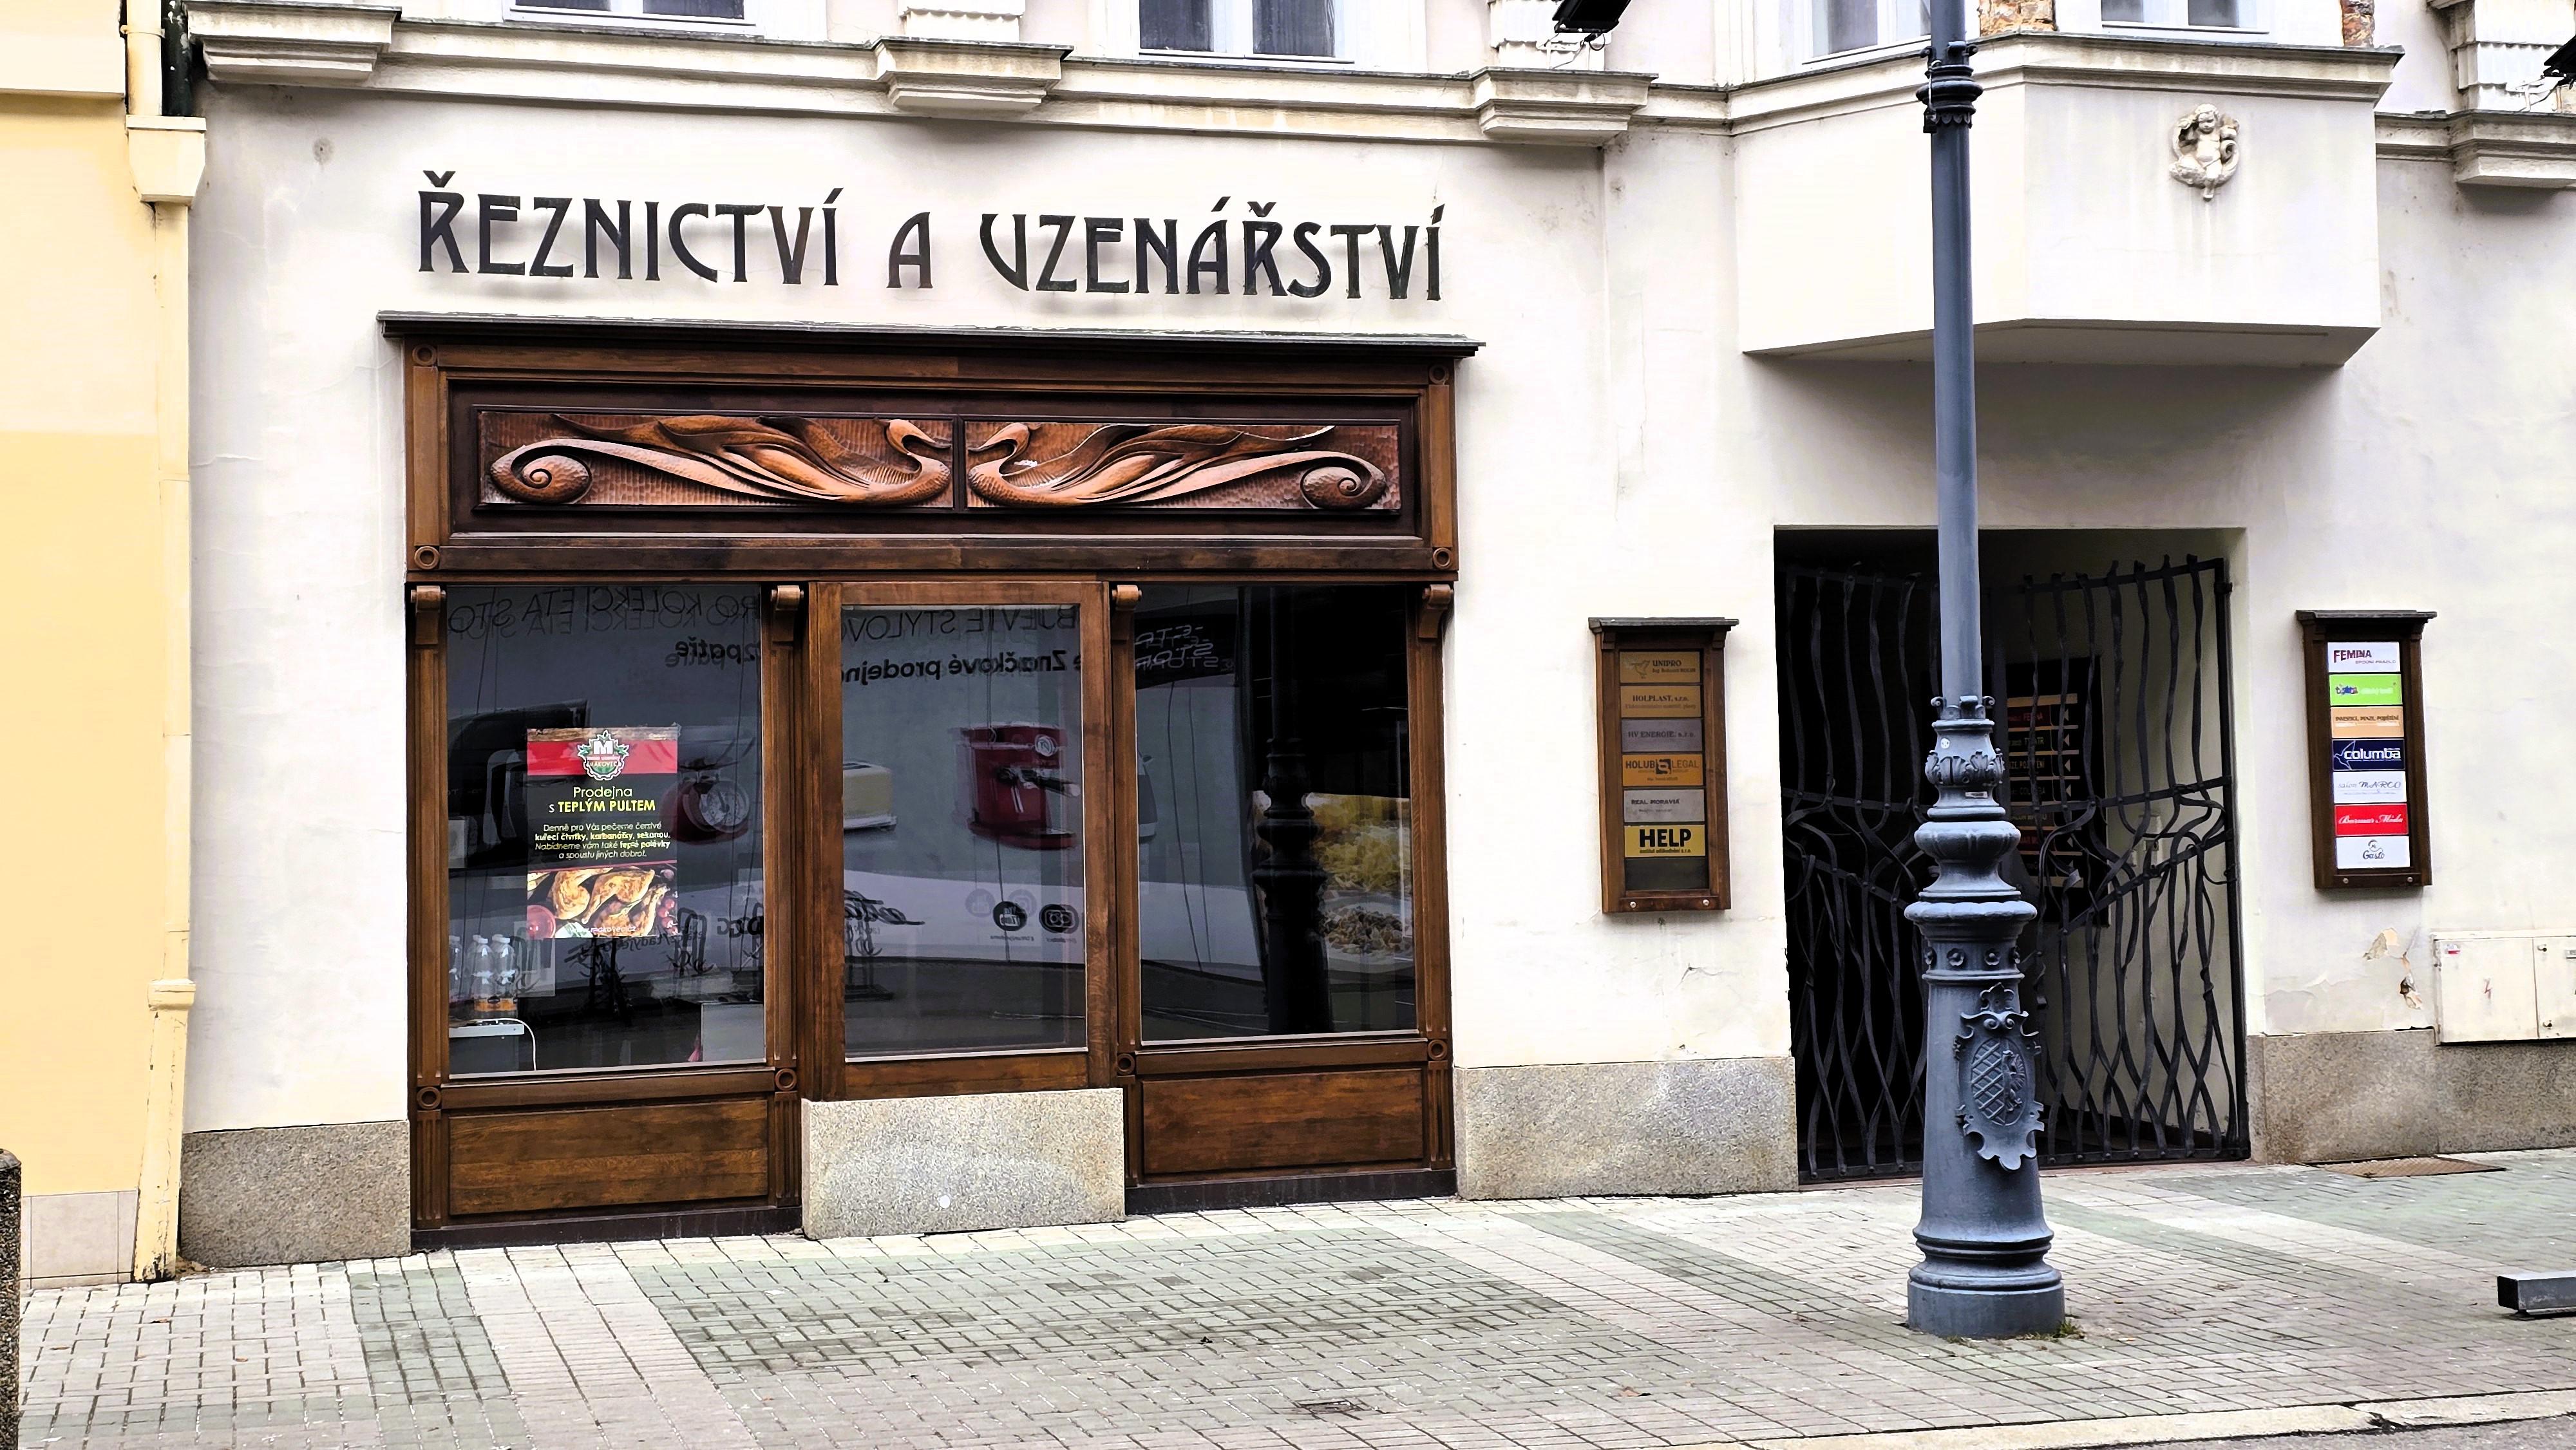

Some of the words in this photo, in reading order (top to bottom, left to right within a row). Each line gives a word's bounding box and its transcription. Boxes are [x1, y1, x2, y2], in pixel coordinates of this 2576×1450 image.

[417, 170, 844, 287] ŘEZNICTVÍ
[886, 211, 933, 289] A
[980, 196, 1446, 302] UZENÁŘSTVÍ
[2333, 650, 2372, 663] FEMINA
[2344, 748, 2401, 760] columba
[1625, 760, 1655, 769] HOLUB
[1672, 760, 1700, 768] LEGAL
[573, 786, 632, 799] Prodejna
[549, 804, 555, 813] s
[558, 798, 605, 813] TEPLÝM
[609, 800, 656, 811] PULTEM
[571, 824, 584, 833] pro
[1639, 828, 1692, 847] HELP
